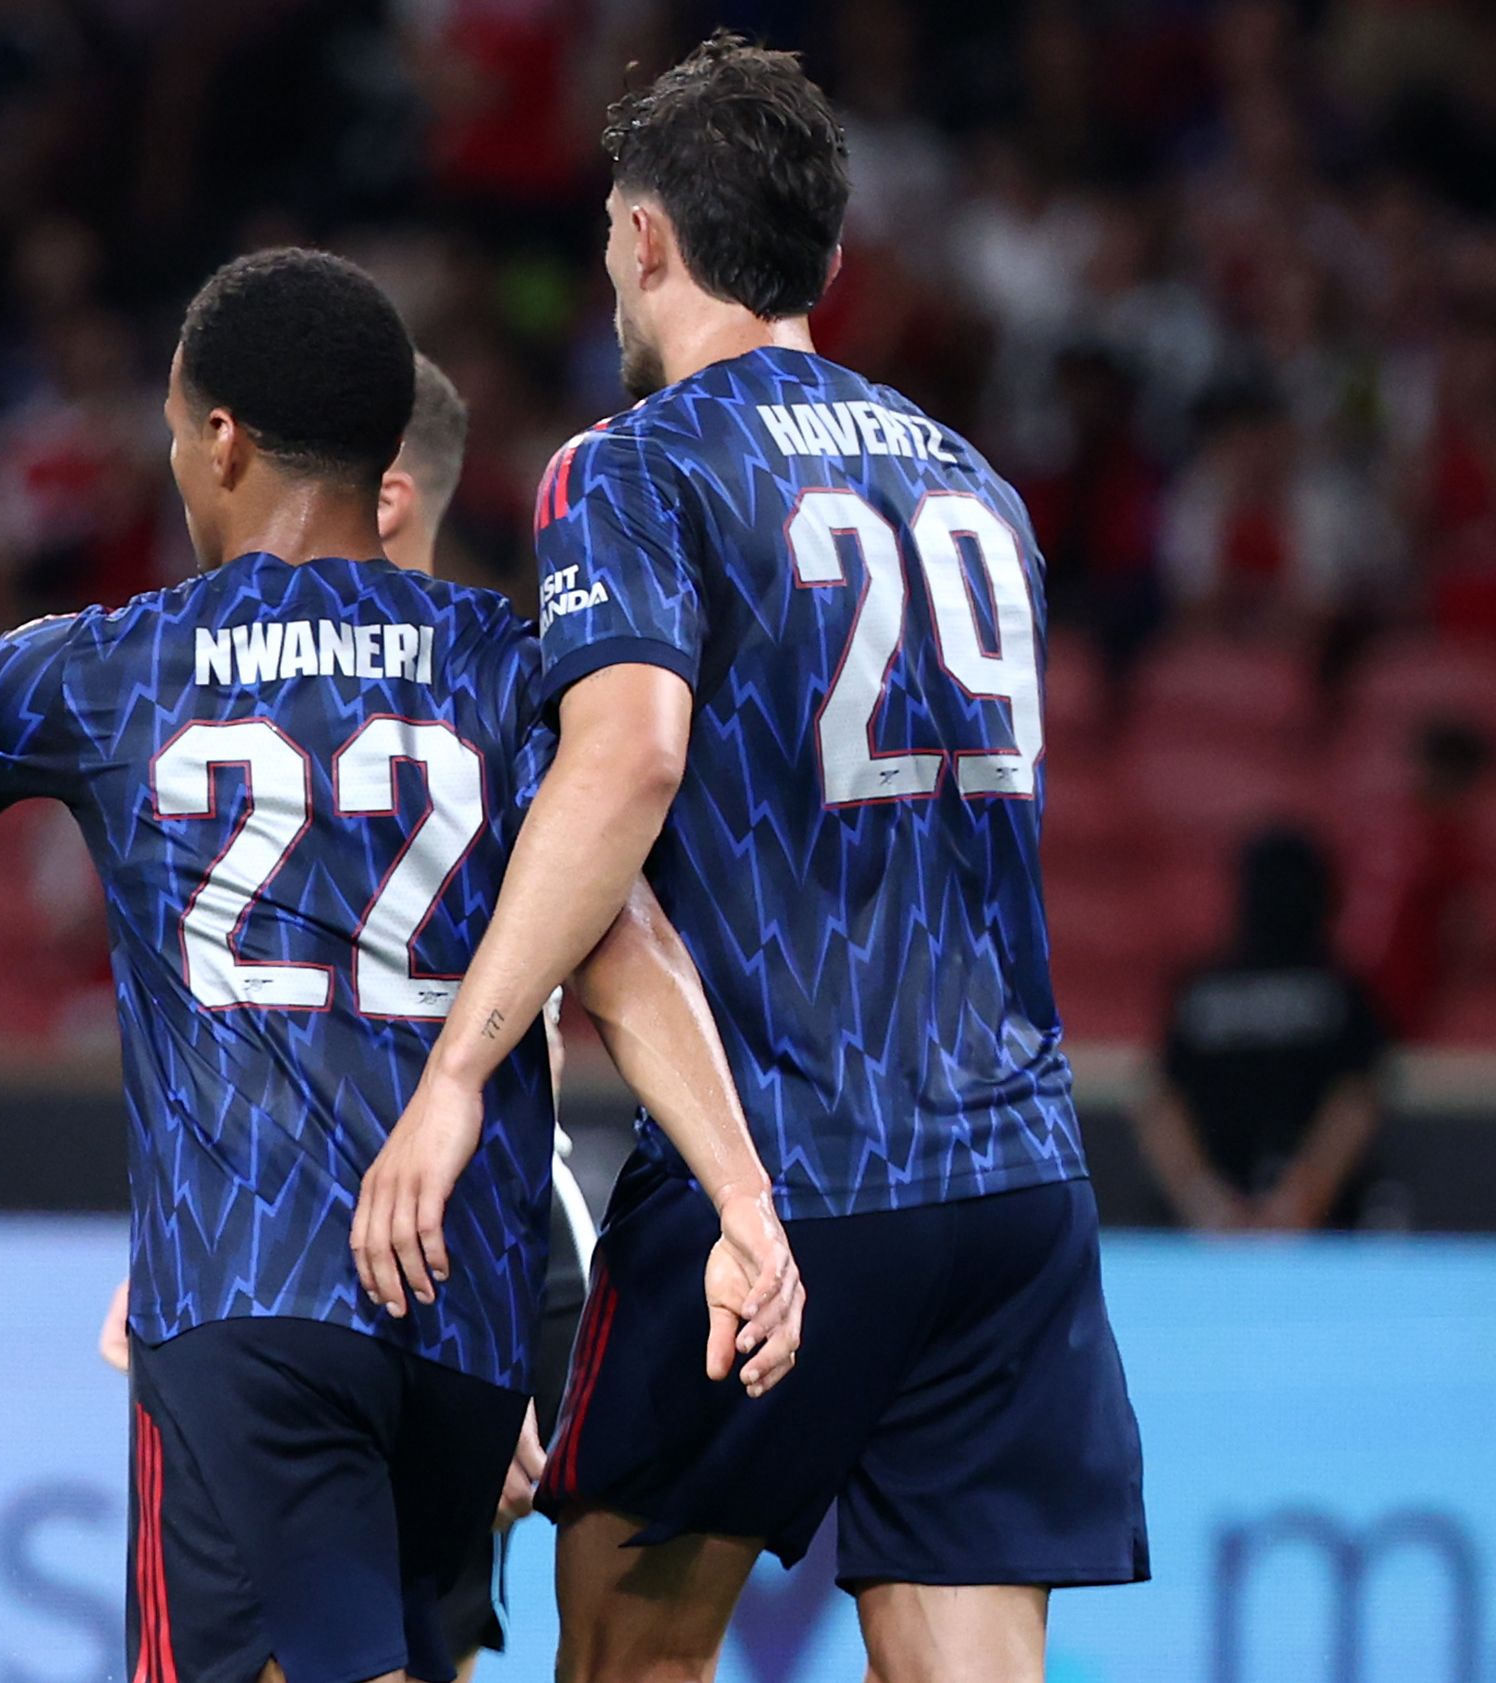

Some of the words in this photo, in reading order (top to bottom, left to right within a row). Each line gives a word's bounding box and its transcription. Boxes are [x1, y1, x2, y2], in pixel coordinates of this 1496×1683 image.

[756, 400, 958, 464] HAVERTZ
[194, 619, 435, 685] NWANERI
[783, 486, 1047, 811] 29
[149, 712, 489, 1022] 22
